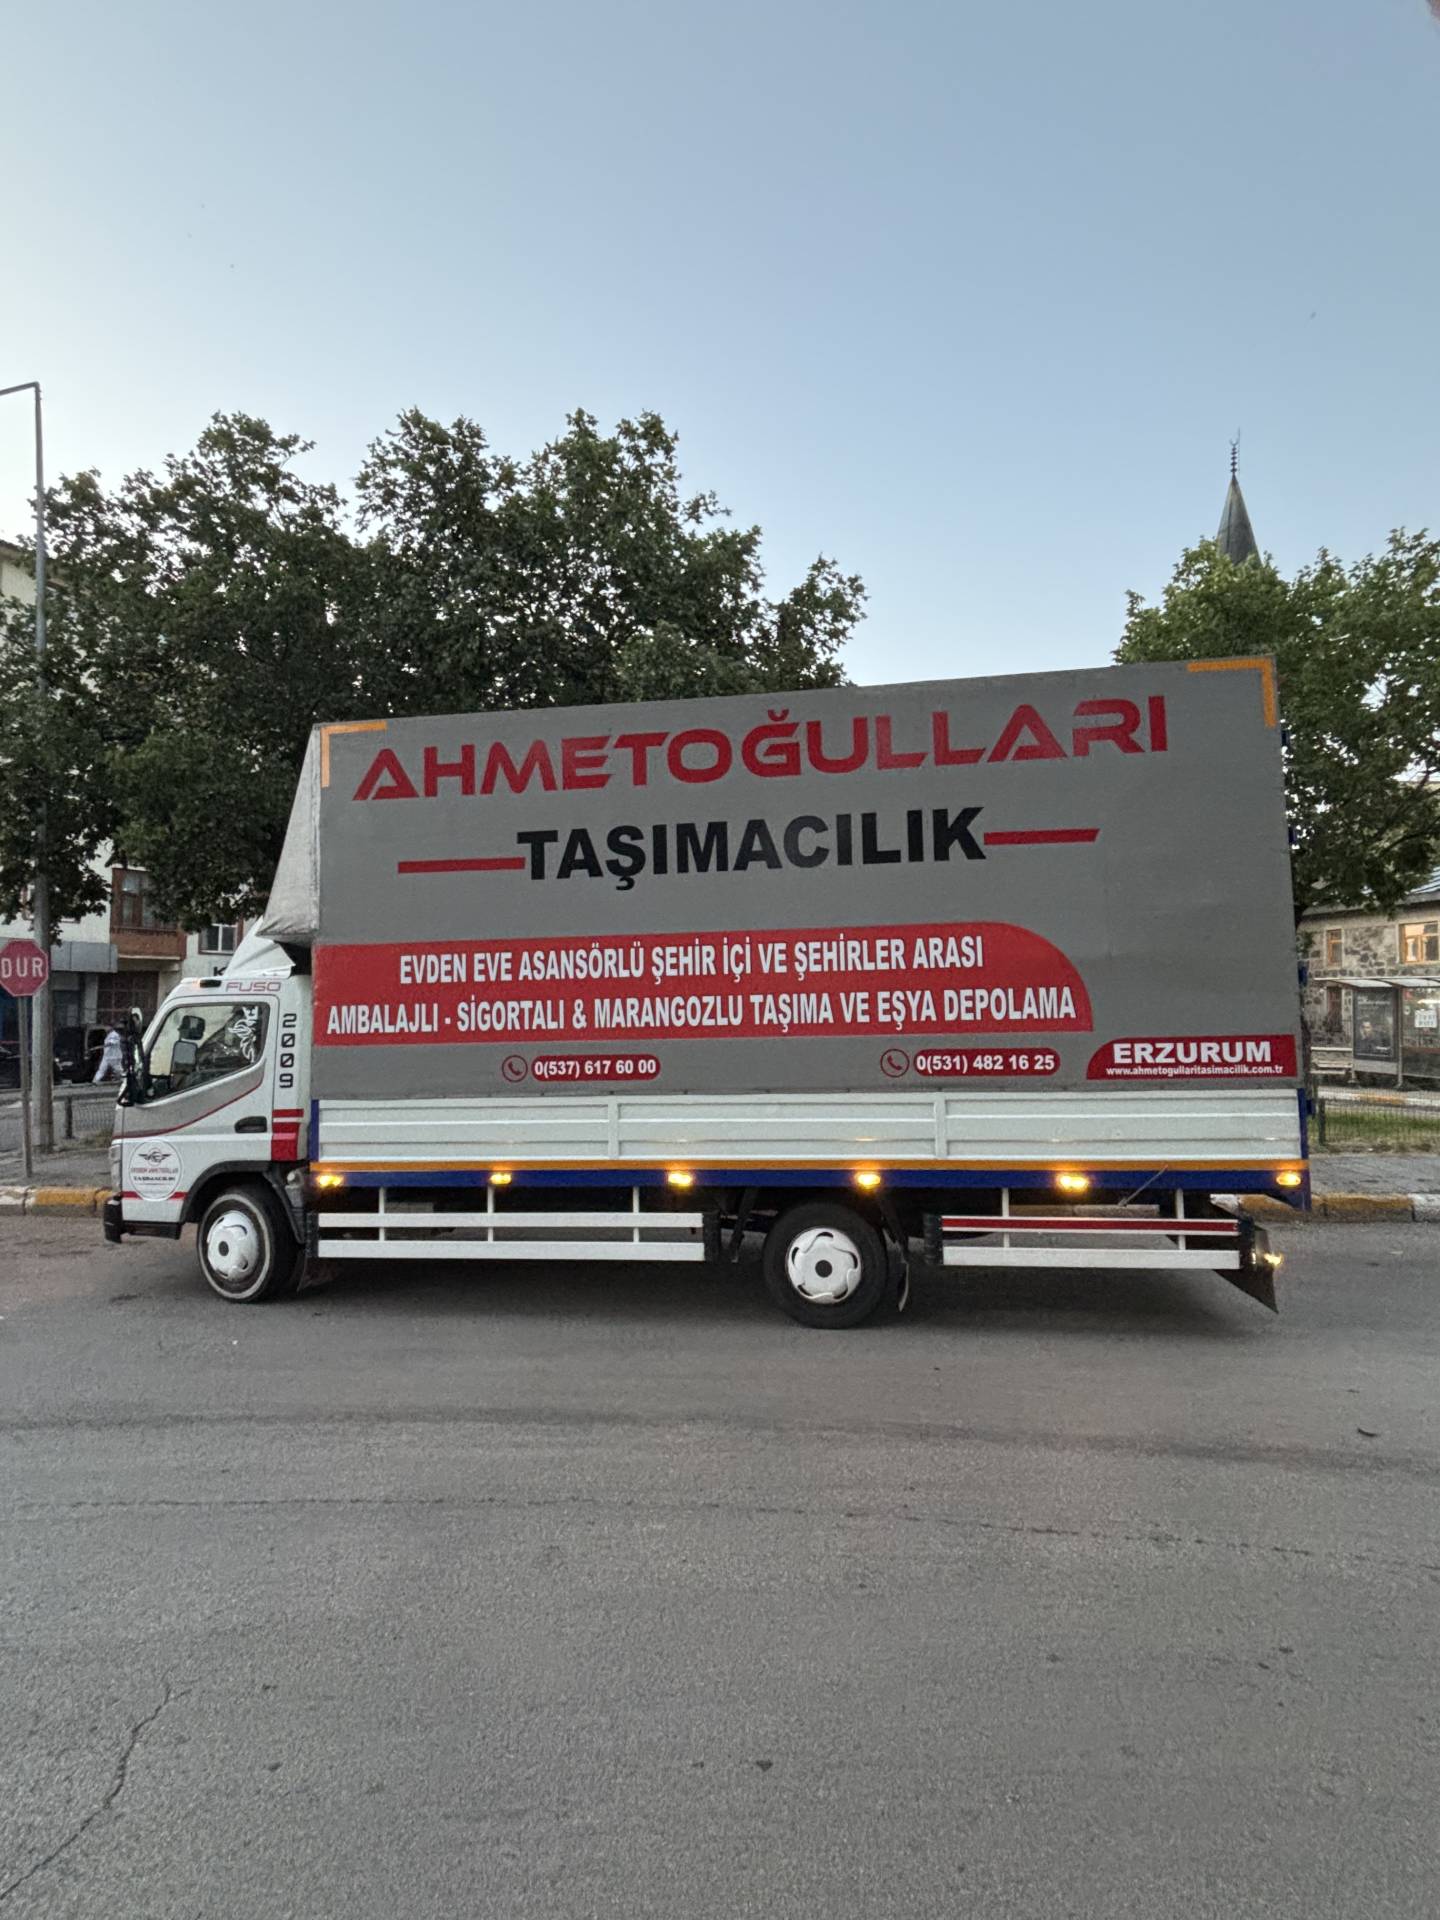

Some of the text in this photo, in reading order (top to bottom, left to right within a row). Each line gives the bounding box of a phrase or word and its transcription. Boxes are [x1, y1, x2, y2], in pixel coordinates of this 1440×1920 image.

[352, 694, 1169, 800] AHMETOĞULLARI
[516, 806, 988, 891] TAŞIMACILIK
[1, 956, 44, 979] DUR
[399, 933, 984, 985] EVDEN EVE ASANSÖRLÜ ŞEHİR İÇİ VE ŞEHİRLER ARASI
[225, 981, 282, 993] FUSO
[326, 1003, 439, 1035] AMBALAJLI
[456, 994, 565, 1032] SİGORTALI
[571, 999, 588, 1029] &
[594, 995, 744, 1029] MARANGOZLU
[749, 992, 834, 1033] TAŞIMA
[839, 991, 870, 1024] VE
[877, 989, 938, 1031] EŞYA
[943, 986, 1077, 1022] DEPOLAMA
[278, 1012, 298, 1089] 2009
[1112, 1040, 1273, 1064] ERZURUM
[534, 1059, 657, 1079] 0(537) 617 60 00
[916, 1054, 1055, 1074] 0(531) 482 16 25
[1105, 1064, 1284, 1077] www.ahmetogullaritasimacilik.com.tr
